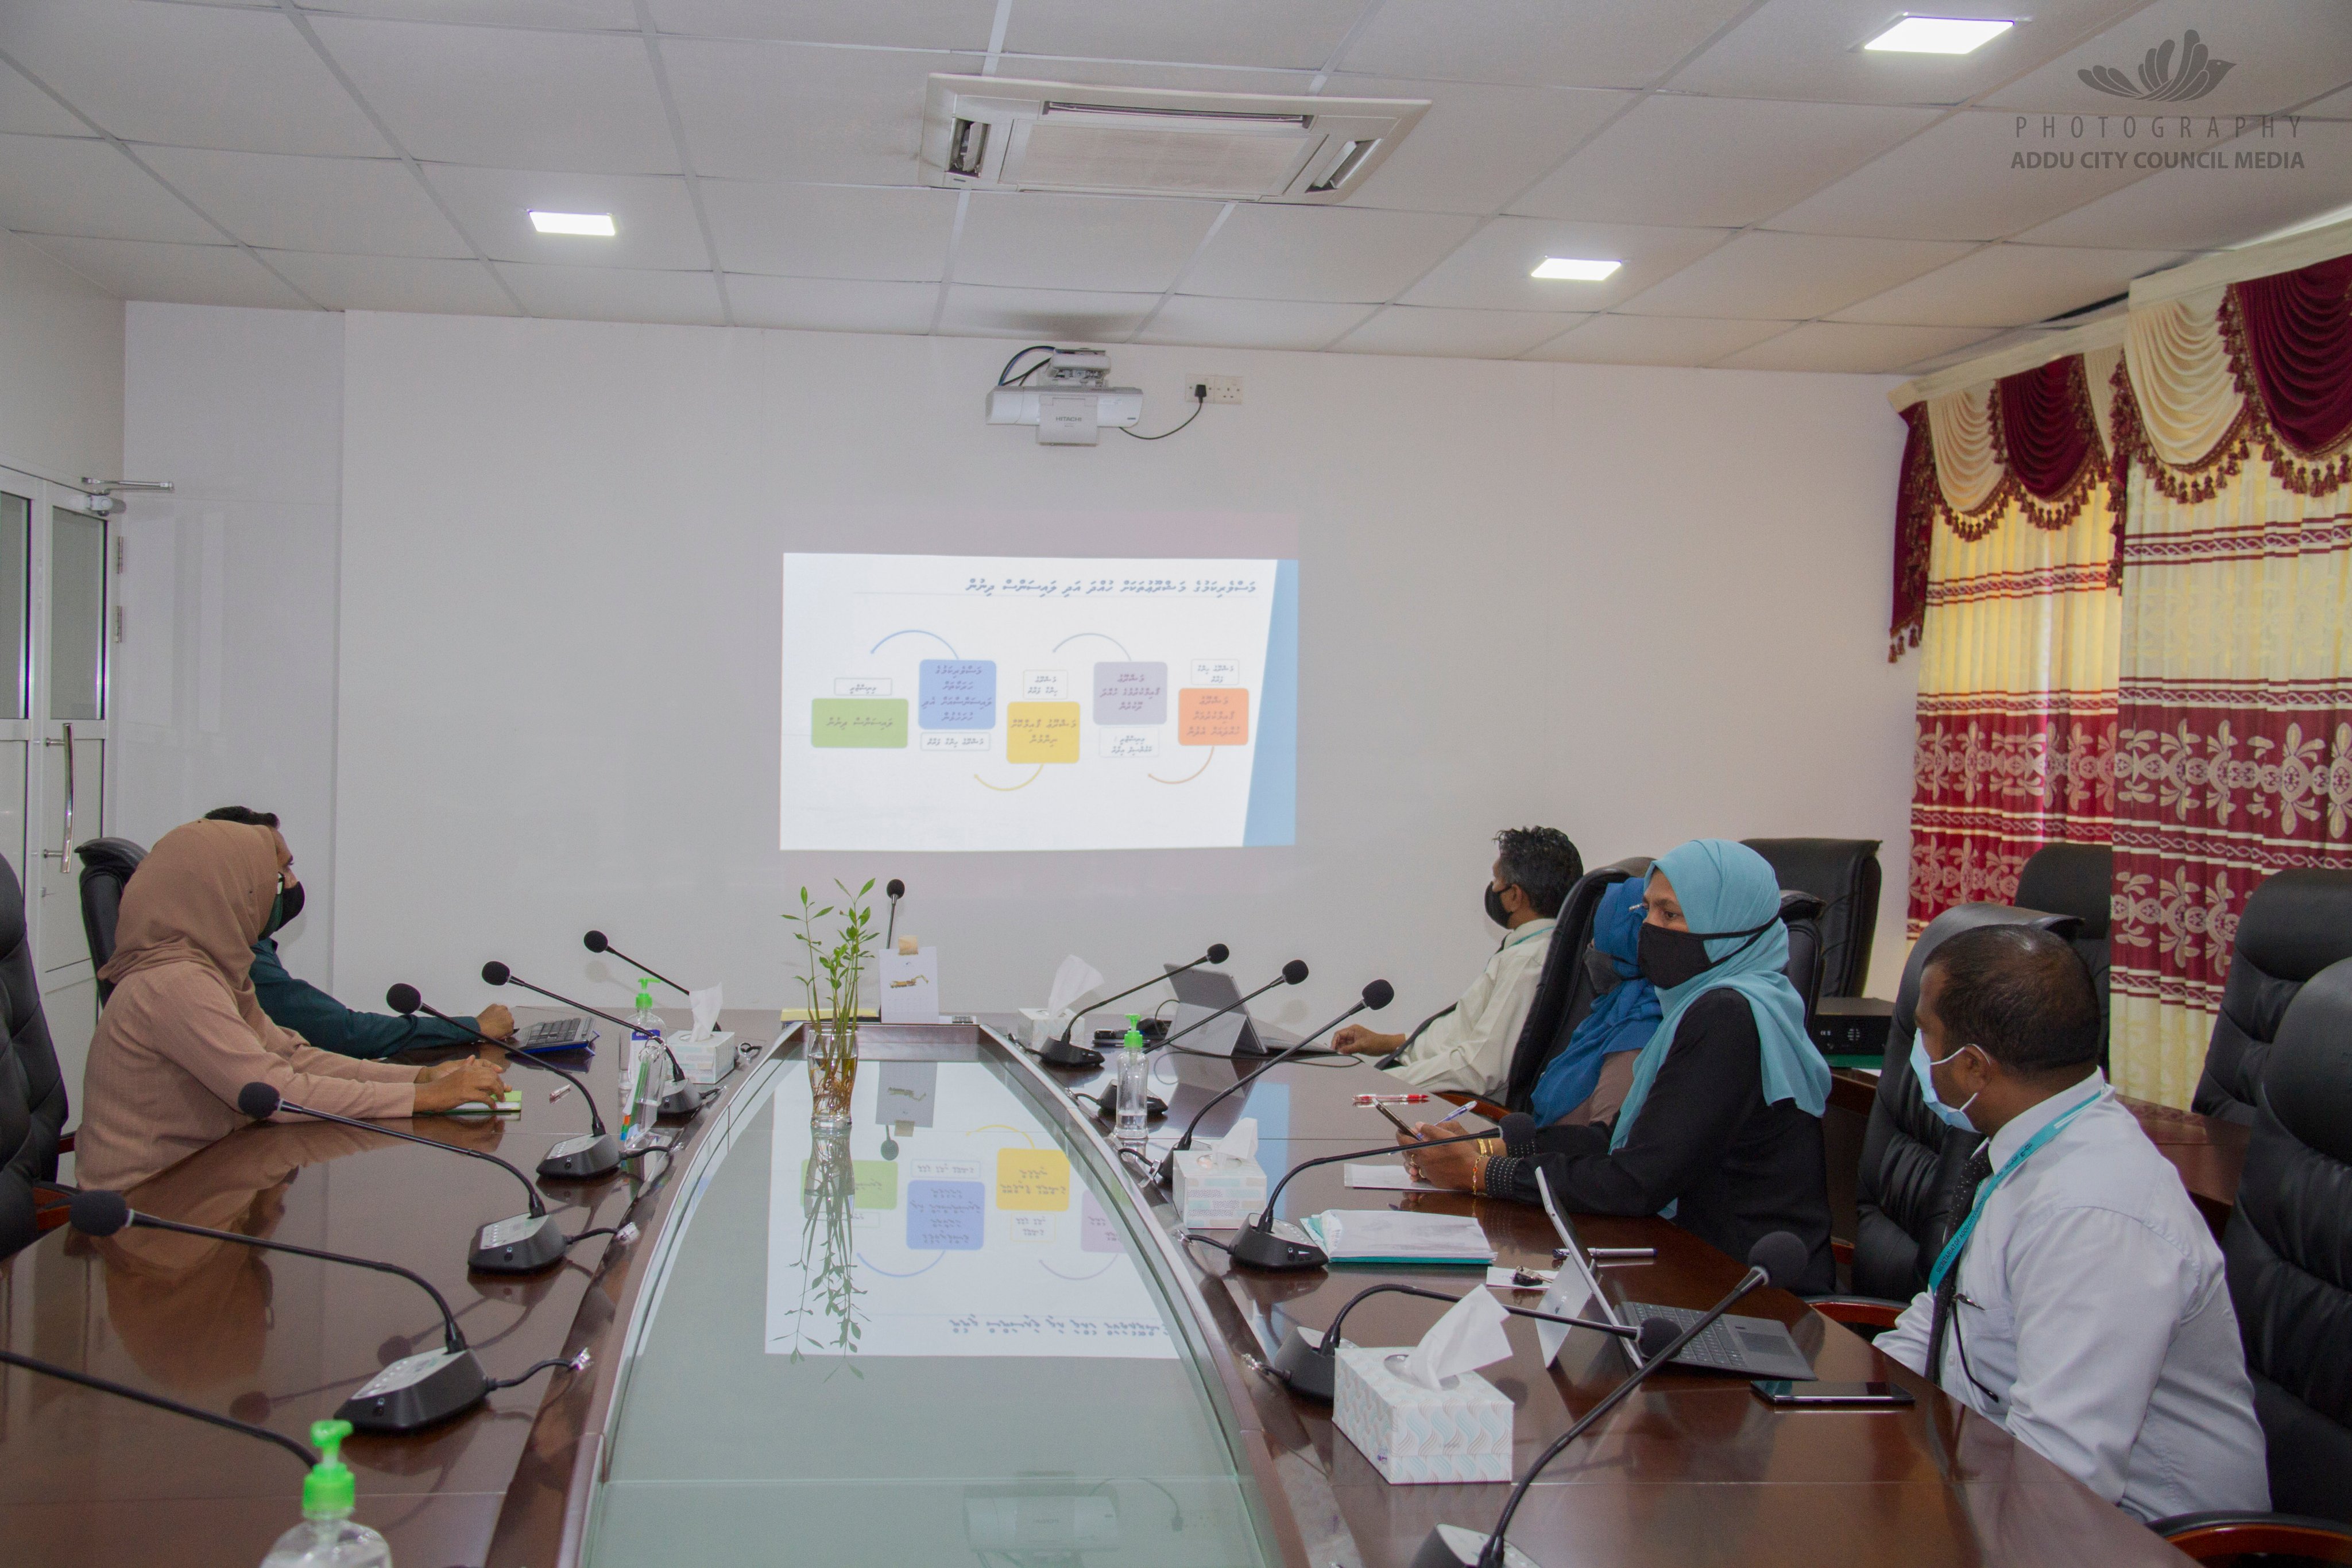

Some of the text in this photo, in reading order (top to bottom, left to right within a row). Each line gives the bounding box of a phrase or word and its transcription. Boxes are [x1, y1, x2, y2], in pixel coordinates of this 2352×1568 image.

[1936, 1244, 1956, 1273] SECRETARIAT
[1953, 1237, 1961, 1246] OF
[1958, 1224, 1970, 1239] ADDU
